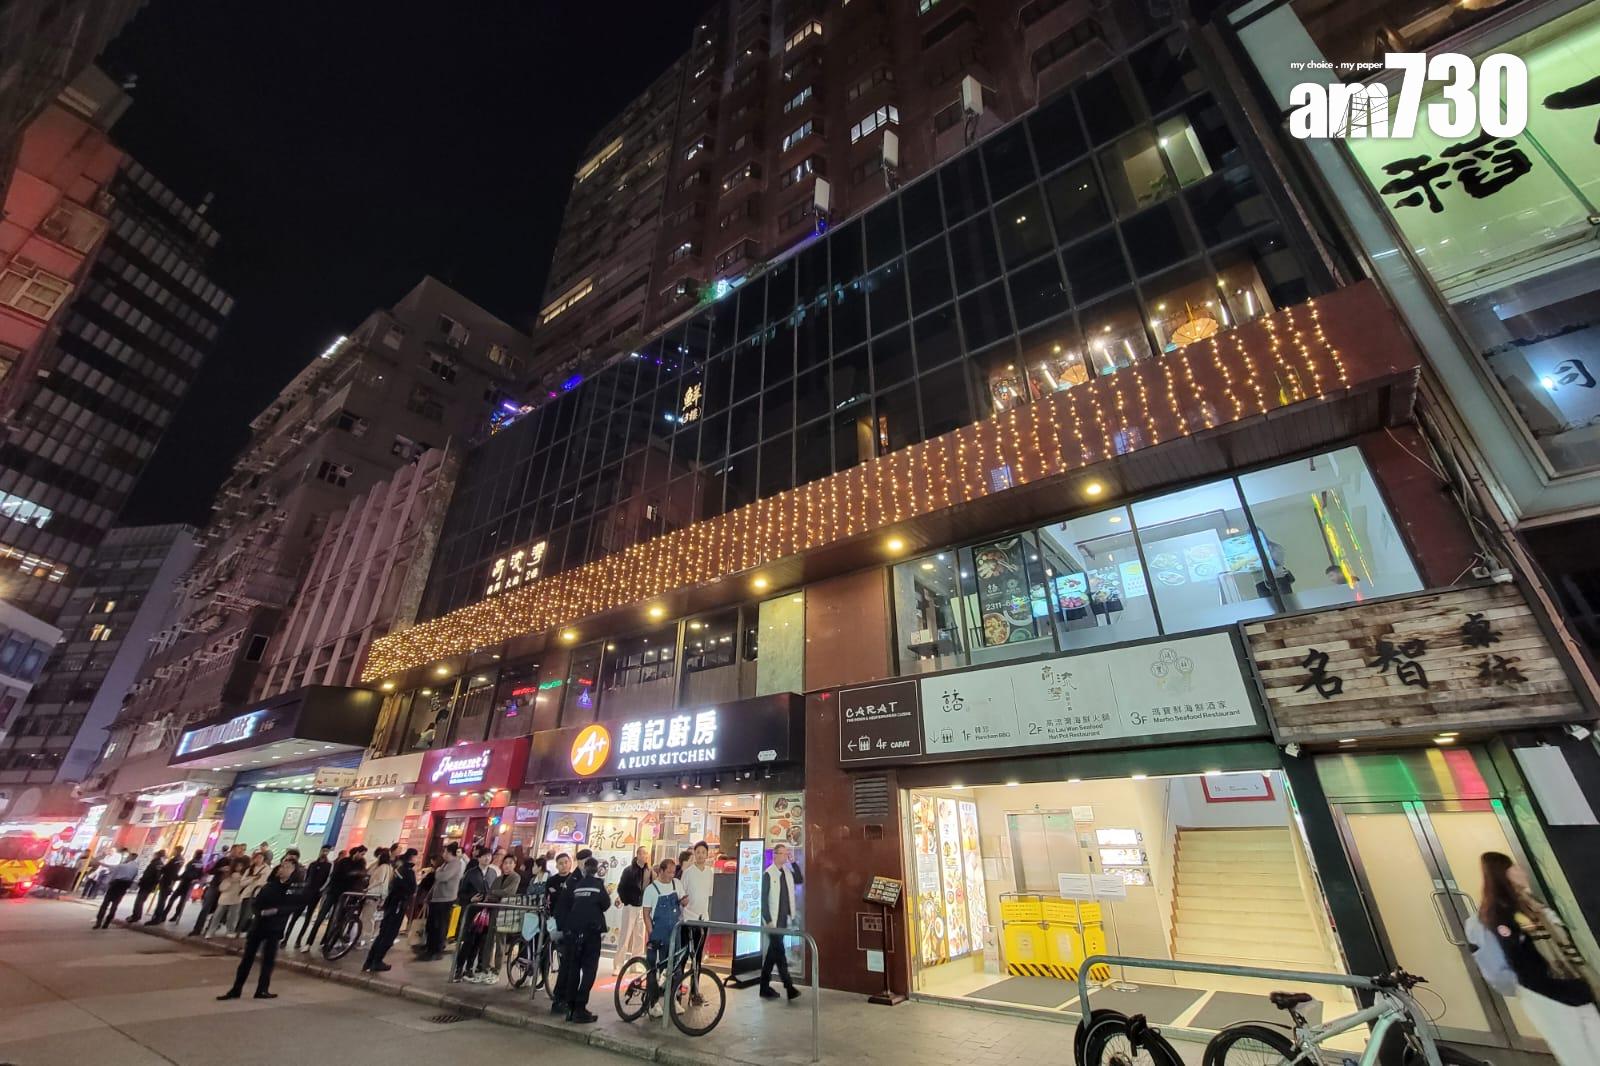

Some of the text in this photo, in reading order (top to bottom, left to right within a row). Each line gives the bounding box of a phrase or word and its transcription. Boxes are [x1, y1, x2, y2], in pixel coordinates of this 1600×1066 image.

[846, 701, 898, 718] CARAT
[1175, 712, 1202, 722] Seafood
[1203, 709, 1241, 719] Restaurant
[1130, 711, 1148, 725] 3F
[618, 709, 718, 754] 讚記廚房
[962, 729, 971, 741] 1F
[1028, 722, 1043, 735] 2F
[876, 738, 911, 749] 4F CARAT
[617, 748, 716, 770] A PLUS KITCHEN
[1137, 832, 1144, 842] 3
